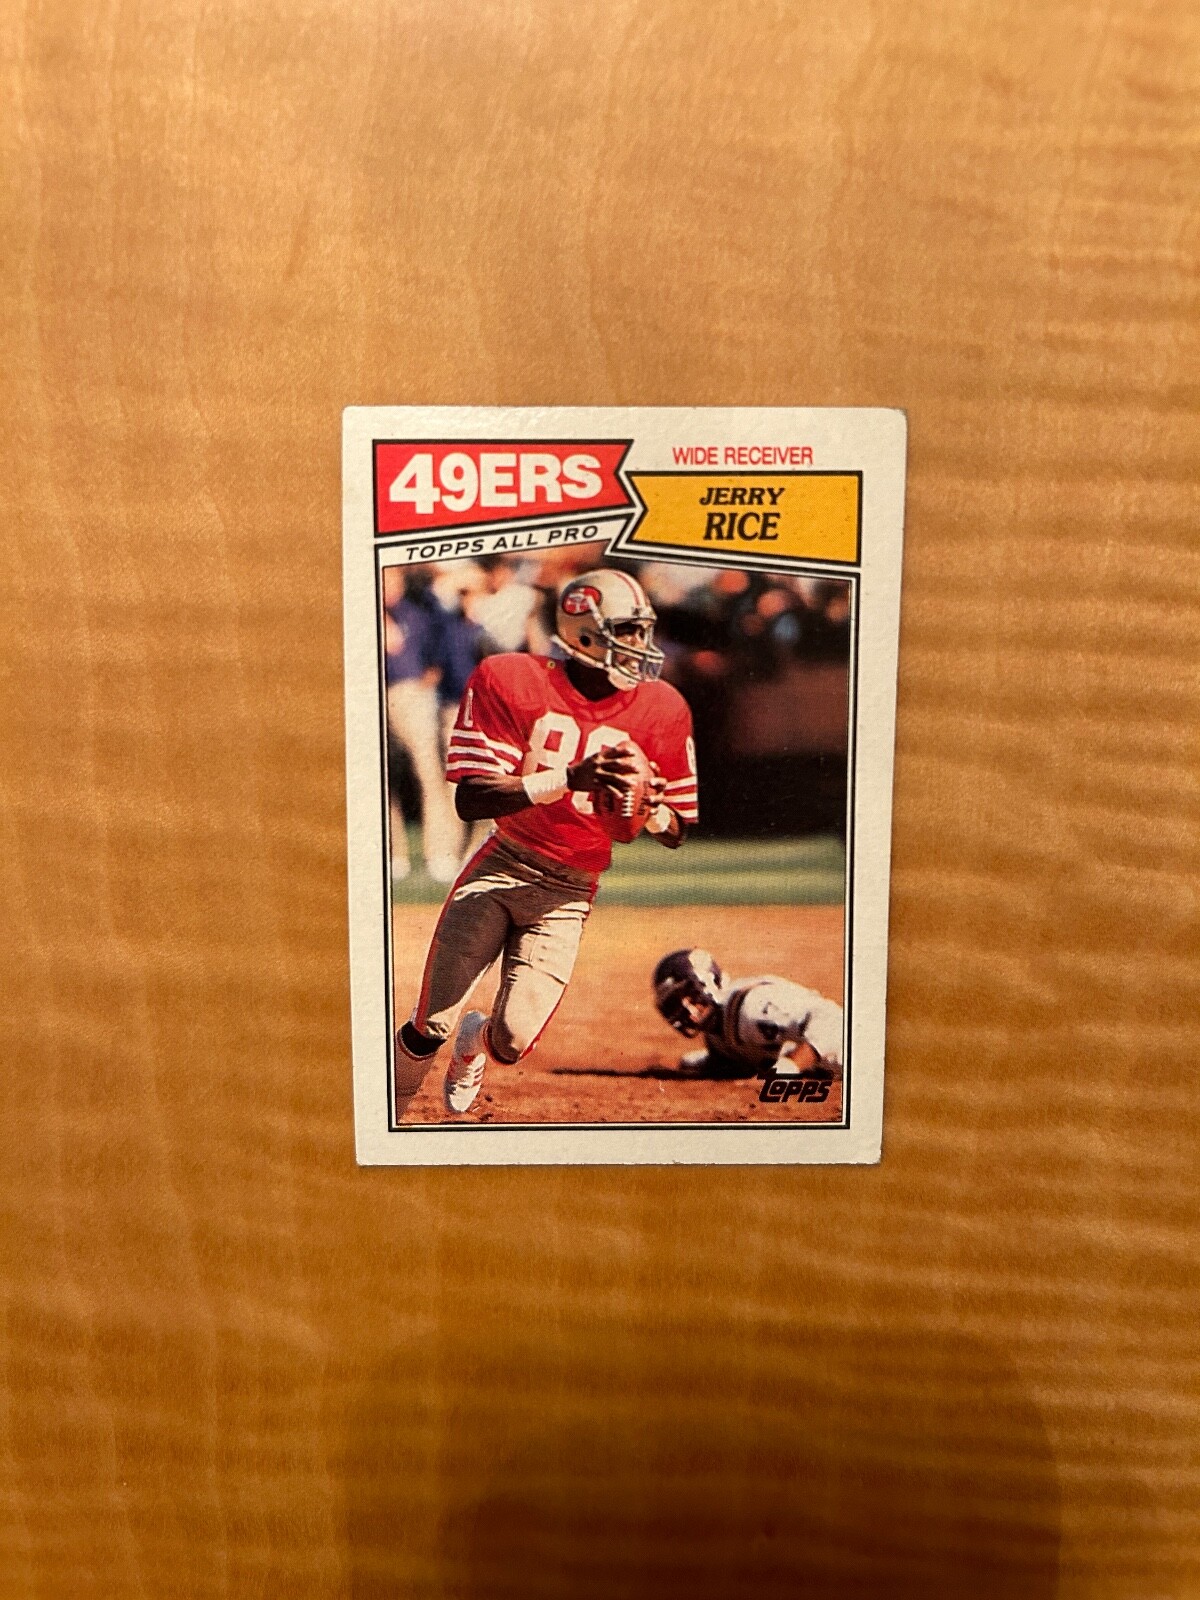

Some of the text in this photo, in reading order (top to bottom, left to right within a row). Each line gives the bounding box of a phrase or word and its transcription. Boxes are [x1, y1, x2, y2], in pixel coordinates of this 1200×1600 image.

[672, 447, 813, 466] WIDE RECEIVER
[389, 452, 603, 514] 49ERS
[699, 487, 785, 506] JERRY
[703, 512, 781, 541] RICE
[406, 525, 598, 561] TOPPS ALL PRO
